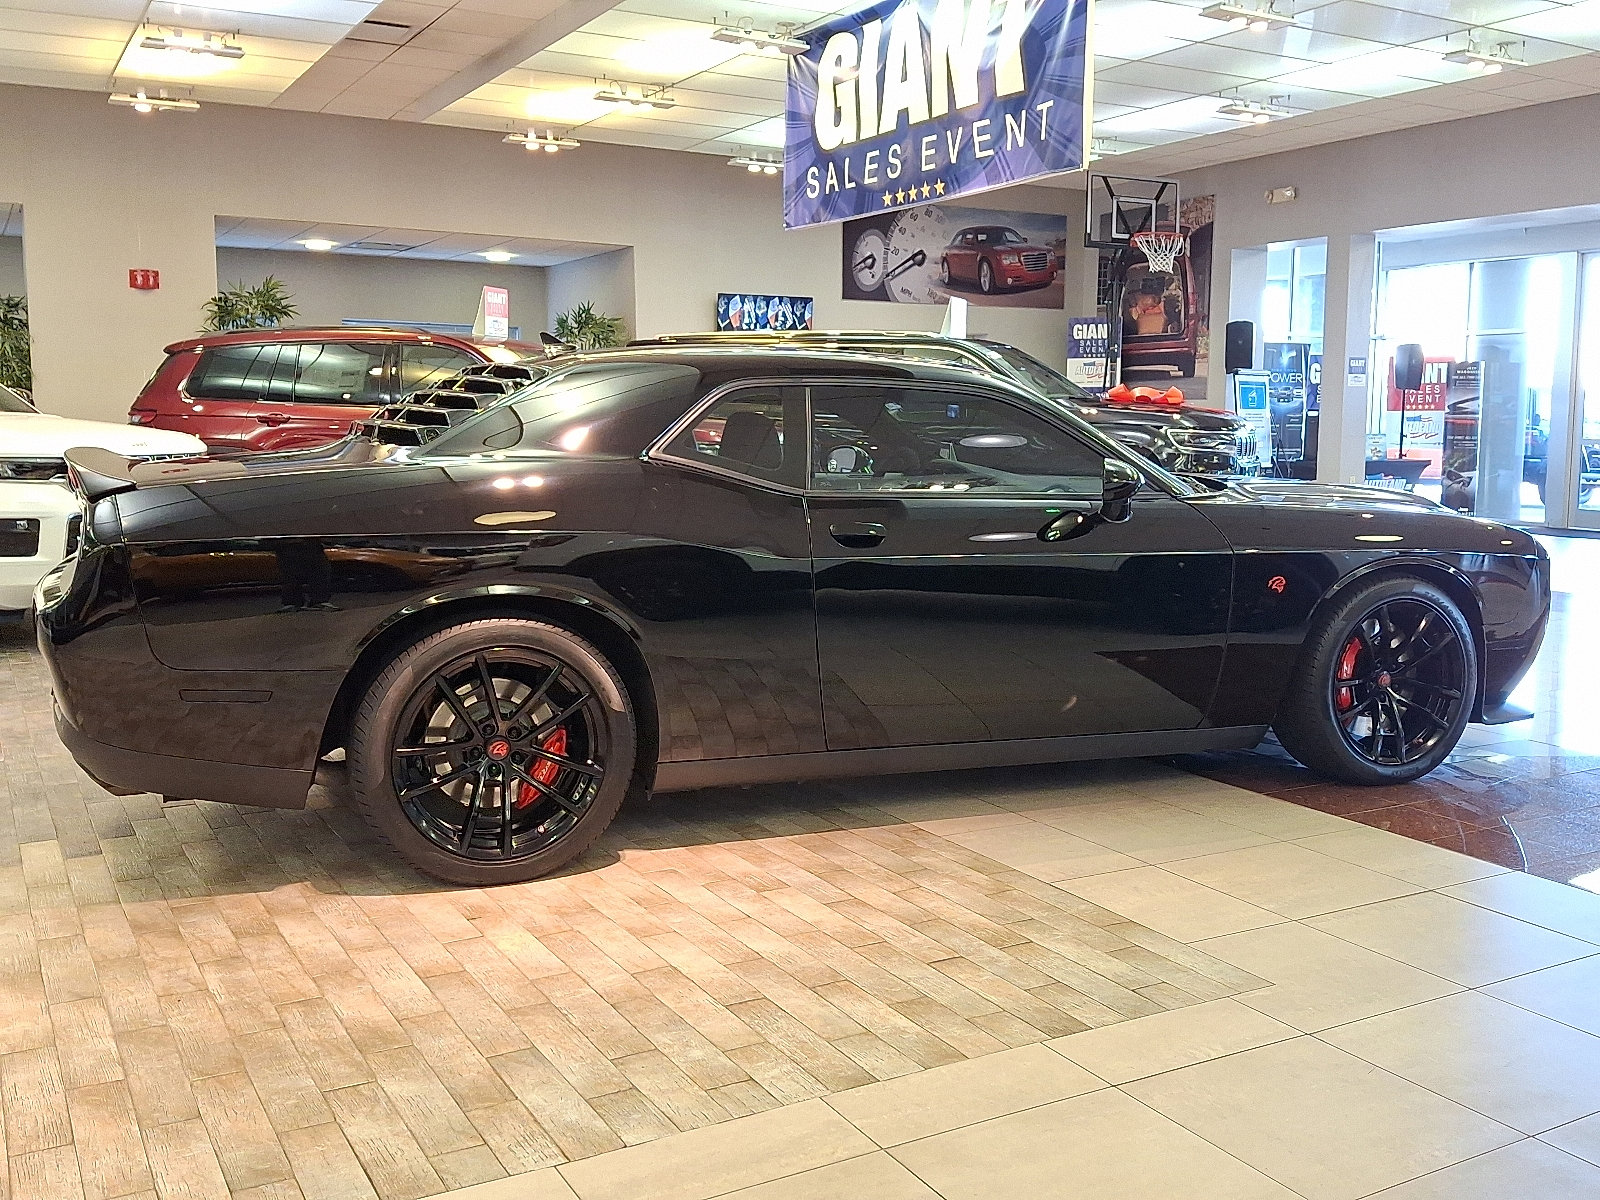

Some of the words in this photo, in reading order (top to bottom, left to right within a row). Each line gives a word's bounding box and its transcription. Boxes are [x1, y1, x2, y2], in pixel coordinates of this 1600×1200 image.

[814, 0, 1036, 151] GIANT
[806, 144, 902, 199] SALES
[921, 100, 1054, 172] EVENT
[1073, 323, 1109, 340] GIAN
[1080, 346, 1105, 354] EVEN
[1406, 394, 1441, 404] VENT
